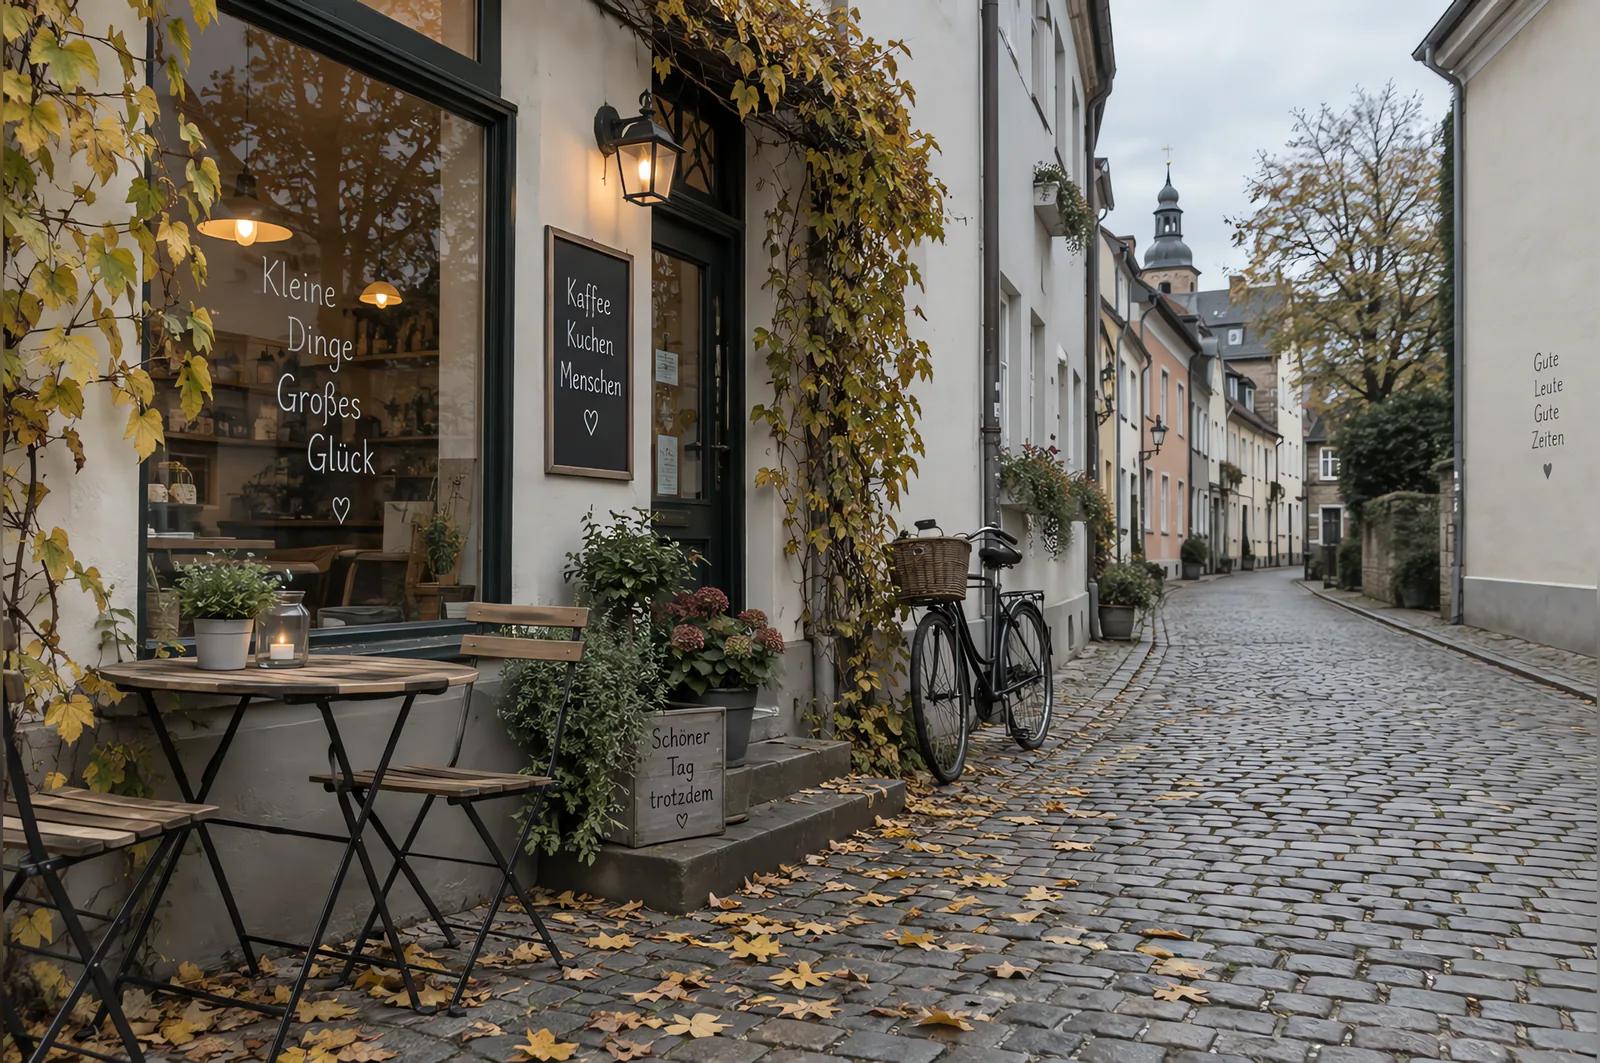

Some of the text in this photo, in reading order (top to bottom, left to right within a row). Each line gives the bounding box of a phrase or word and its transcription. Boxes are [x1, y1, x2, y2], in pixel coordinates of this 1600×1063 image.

[262, 255, 336, 308] Kleine
[567, 276, 611, 318] Kaffee
[287, 316, 353, 373] Dinge
[567, 320, 614, 356] Kuchen
[1533, 352, 1559, 372] Gute
[560, 360, 622, 397] Menschen
[1534, 377, 1563, 397] Leute
[277, 373, 361, 426] Großes
[1534, 404, 1560, 423] Gute
[308, 433, 376, 475] Glück
[1531, 430, 1565, 449] Zeiten
[652, 727, 710, 749] Schöner
[666, 756, 694, 782] Tag
[650, 785, 714, 809] trotzdem
